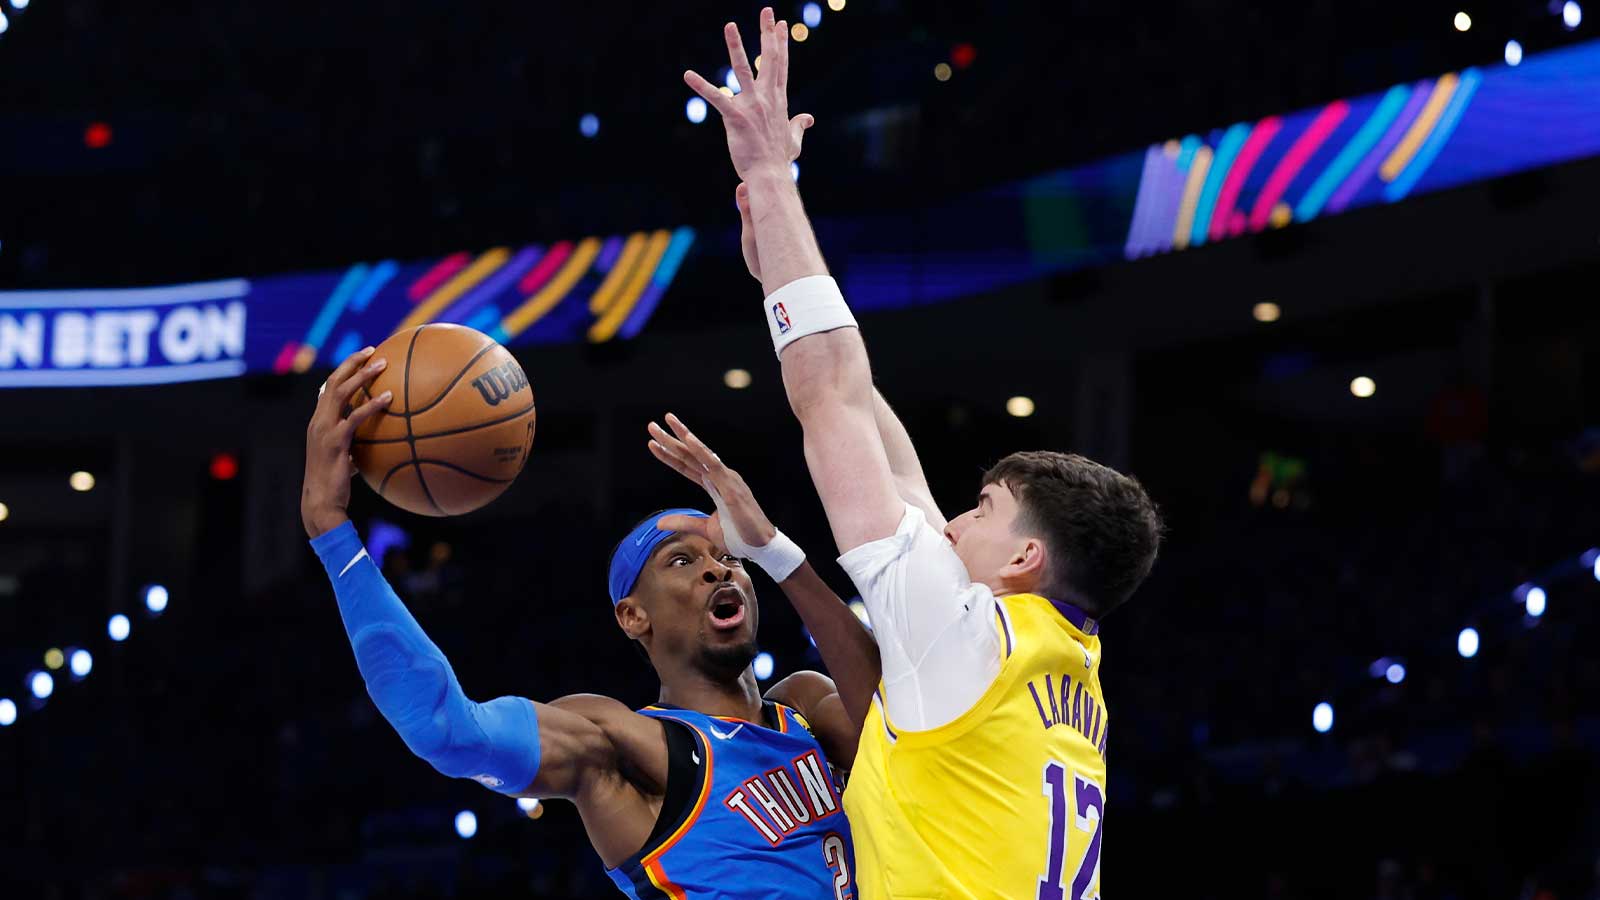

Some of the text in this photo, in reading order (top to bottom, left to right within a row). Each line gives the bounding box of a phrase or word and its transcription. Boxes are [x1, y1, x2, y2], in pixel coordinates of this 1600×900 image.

[52, 309, 159, 369] BET
[159, 300, 247, 364] ON
[724, 750, 848, 847] THUN
[1037, 758, 1106, 900] 12
